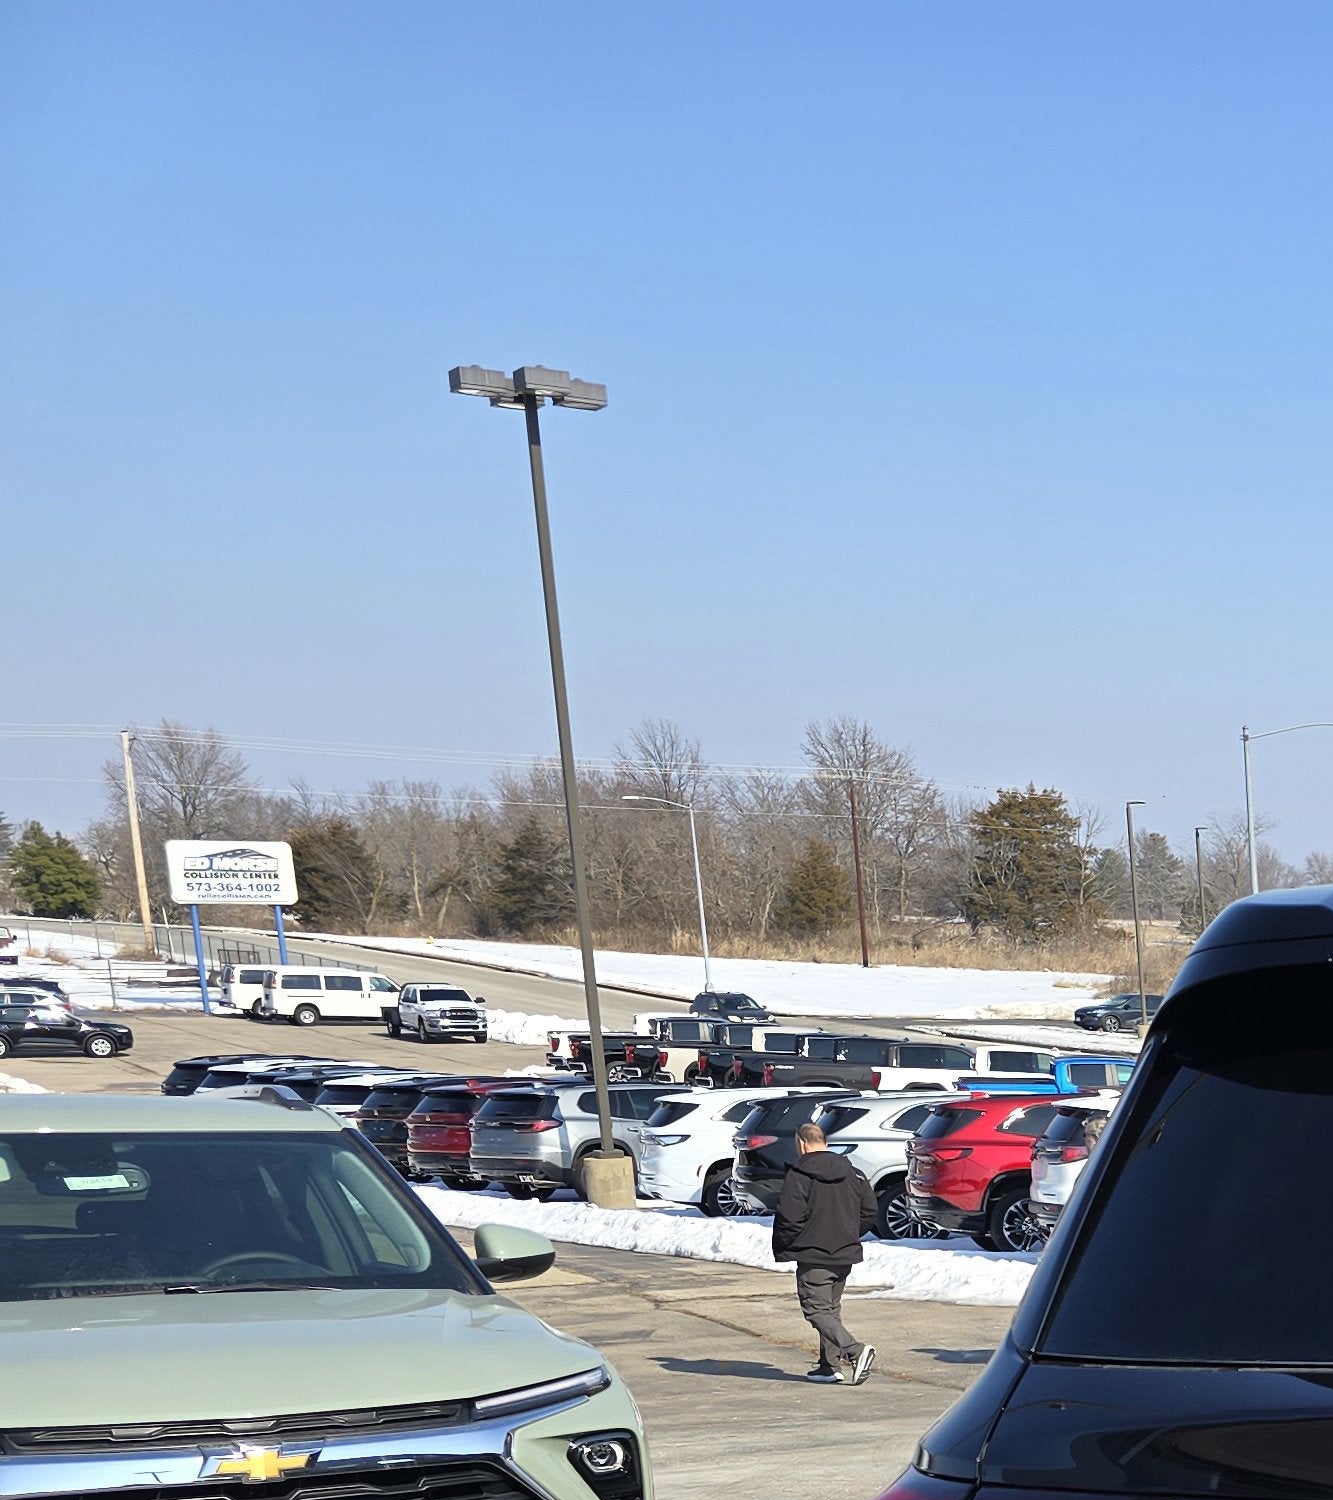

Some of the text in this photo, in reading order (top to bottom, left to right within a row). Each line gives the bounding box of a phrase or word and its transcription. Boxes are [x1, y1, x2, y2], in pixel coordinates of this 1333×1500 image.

[184, 856, 278, 872] ED MORSE
[183, 871, 280, 880] COLLISION CENTER
[186, 882, 281, 892] 573-364-1002
